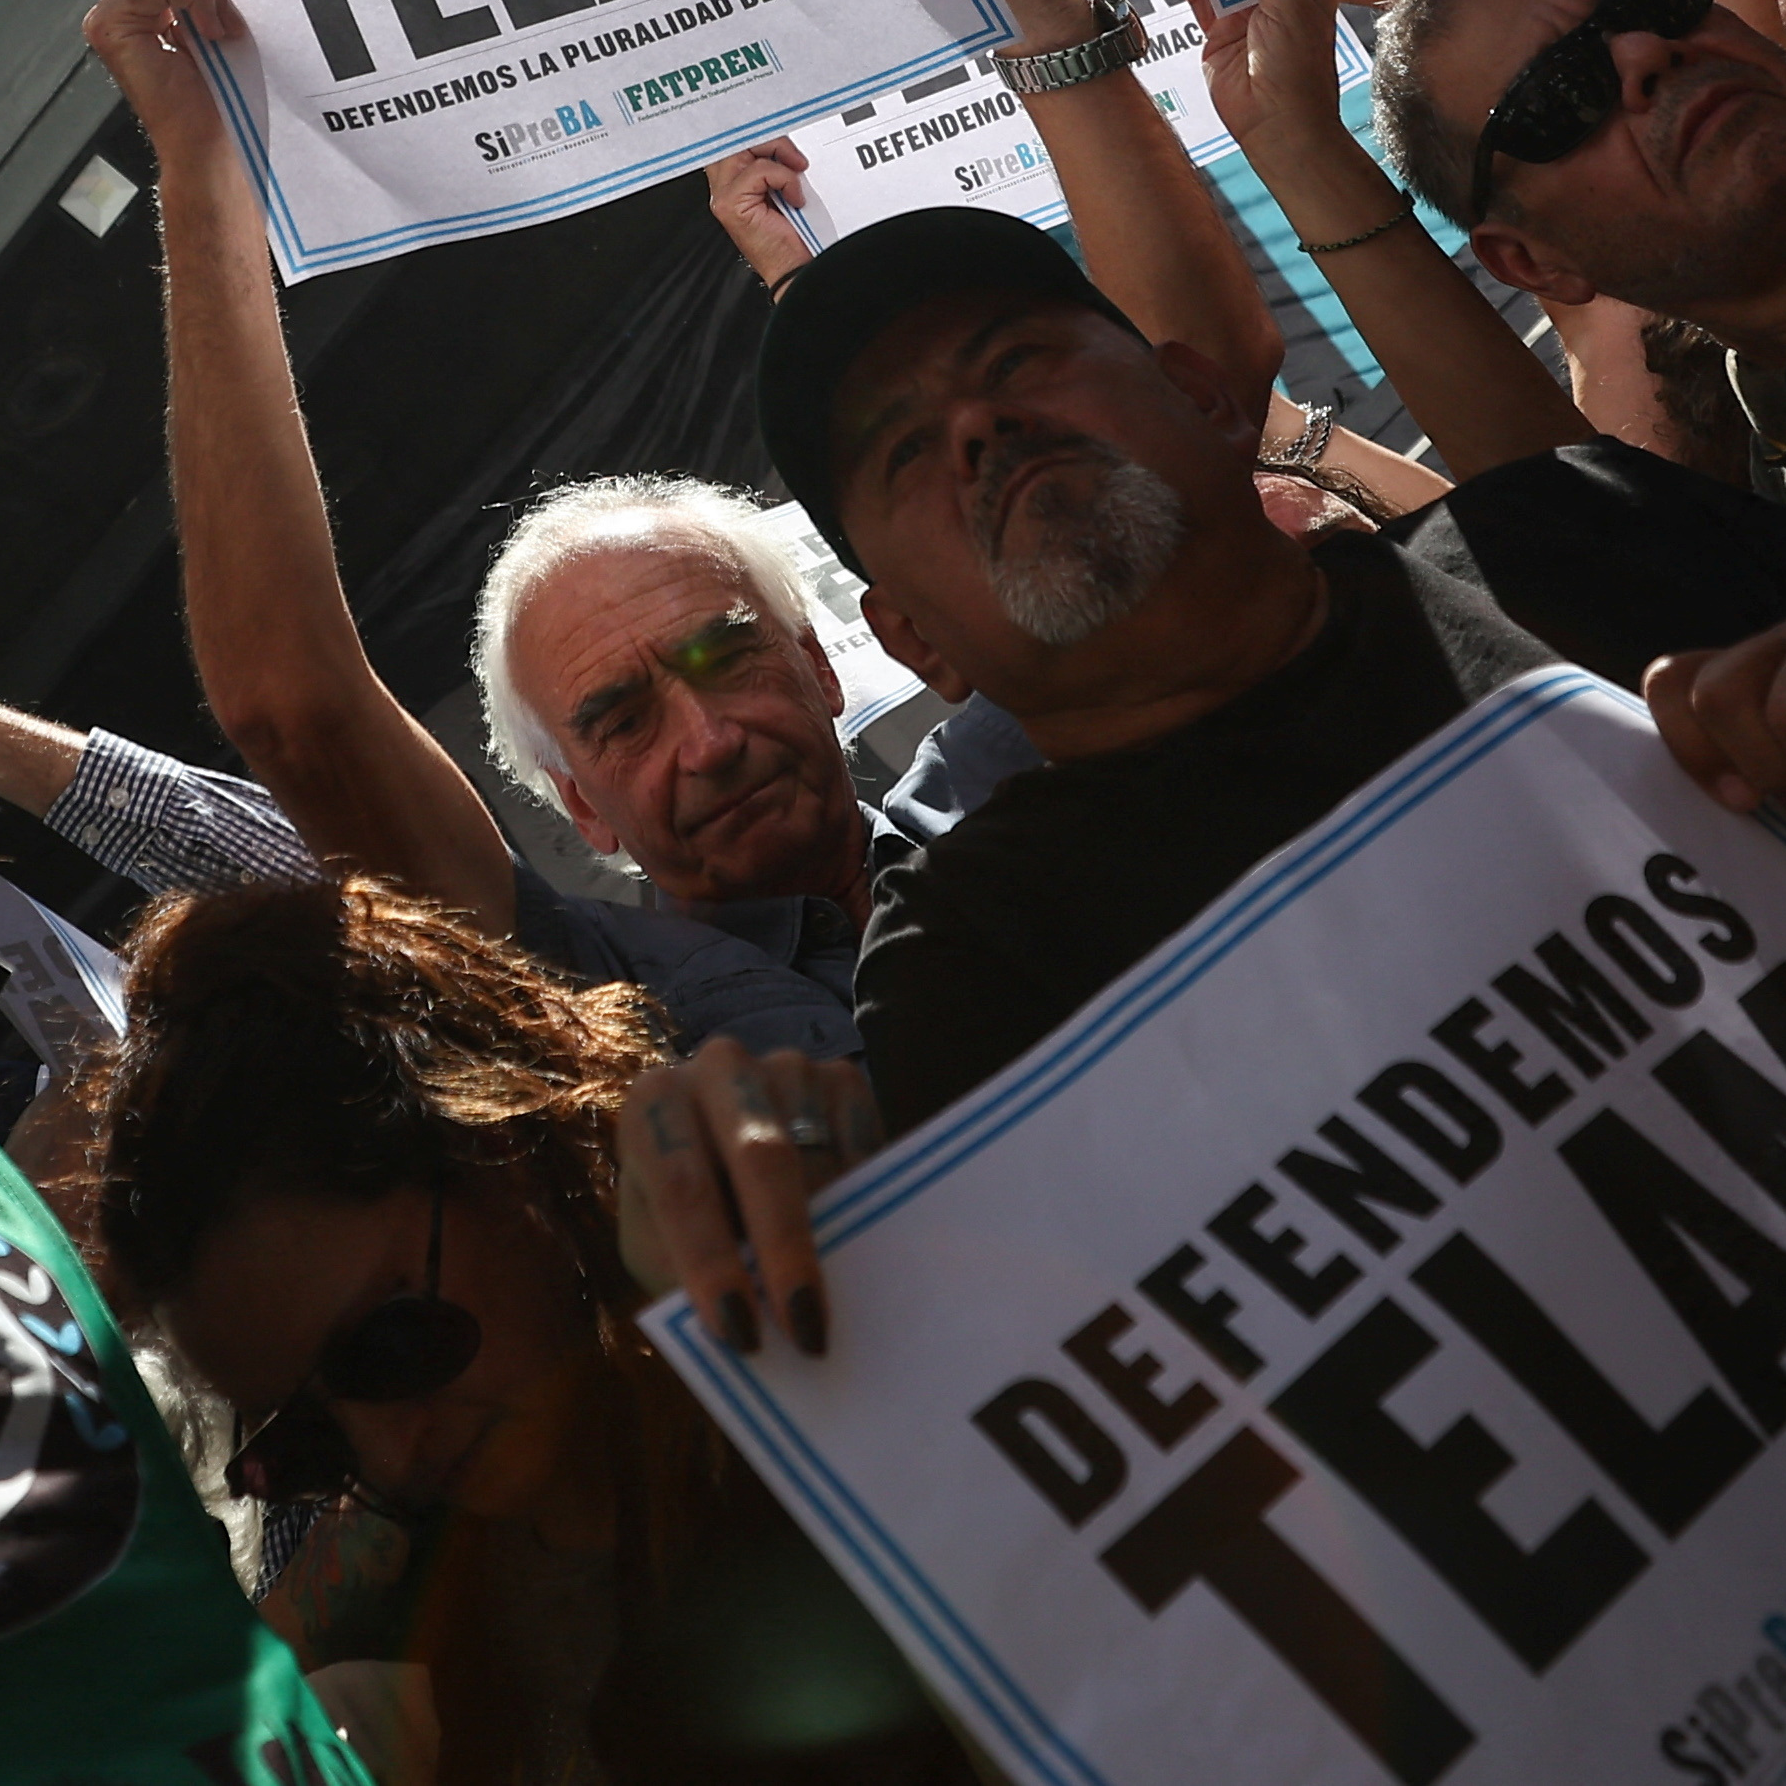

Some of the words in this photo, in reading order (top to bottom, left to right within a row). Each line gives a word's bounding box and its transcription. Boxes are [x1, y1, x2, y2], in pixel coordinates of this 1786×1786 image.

[322, 65, 517, 133] DEFENDEMOS
[521, 54, 560, 81] LA
[623, 42, 769, 112] FATPREN
[475, 100, 602, 162] SiPreBA
[856, 89, 1022, 170] DEFENDEMO
[970, 851, 1757, 1530] DEFENDEMOS
